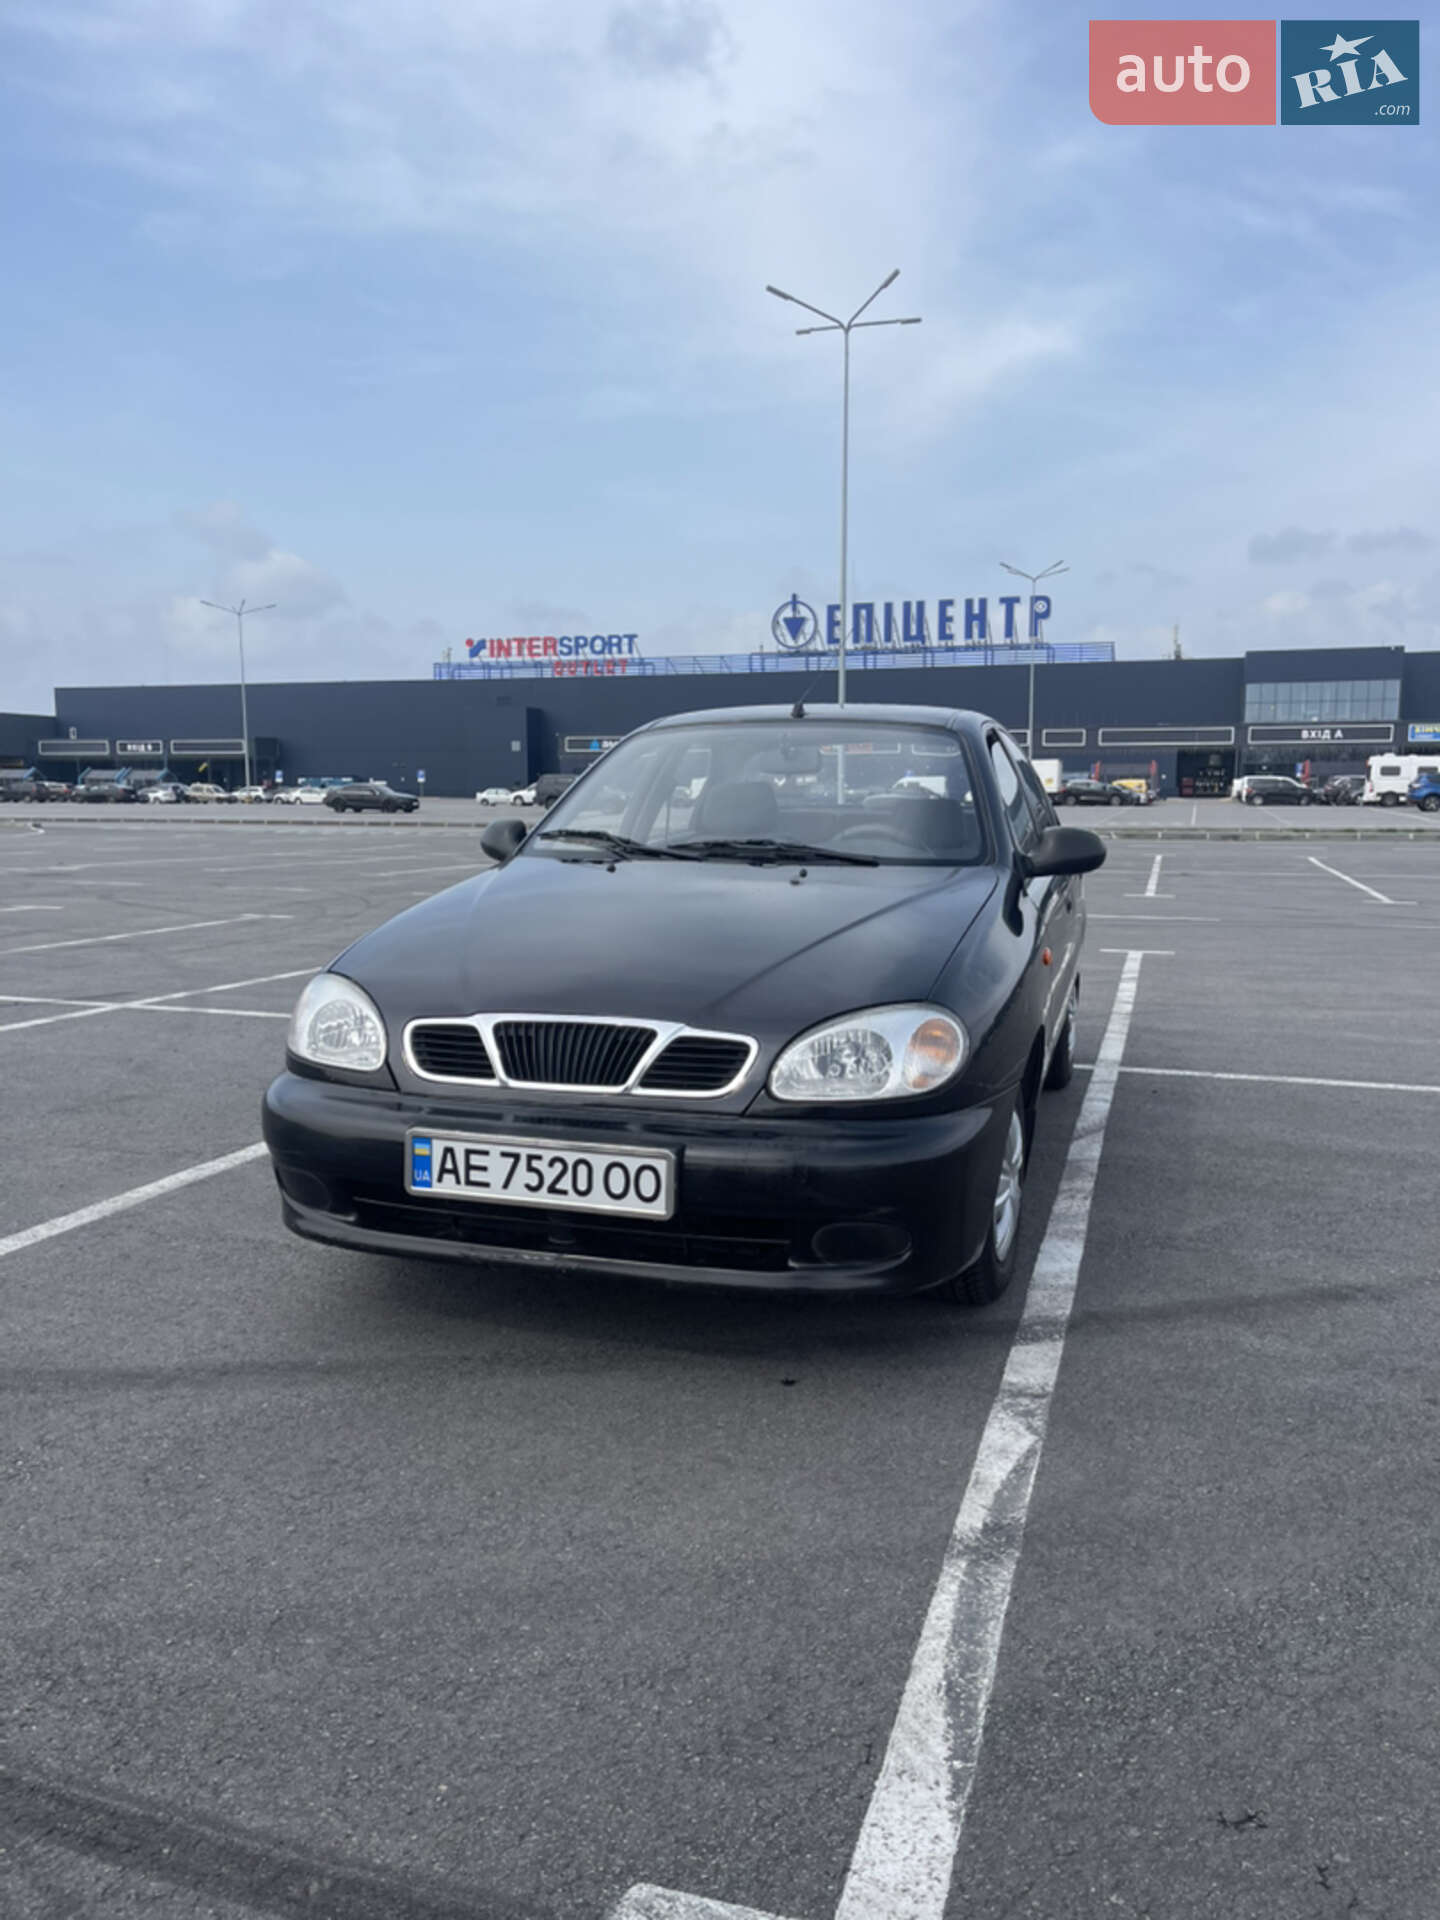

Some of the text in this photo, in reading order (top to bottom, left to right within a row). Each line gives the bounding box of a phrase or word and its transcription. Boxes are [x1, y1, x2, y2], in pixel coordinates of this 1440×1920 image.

[826, 595, 1052, 645] ЕПІЦЕНТР
[488, 634, 638, 659] INTERSPORT
[553, 658, 628, 677] OUTLET
[413, 1168, 431, 1182] UA
[436, 1146, 491, 1189] AE
[499, 1150, 593, 1197] 7520
